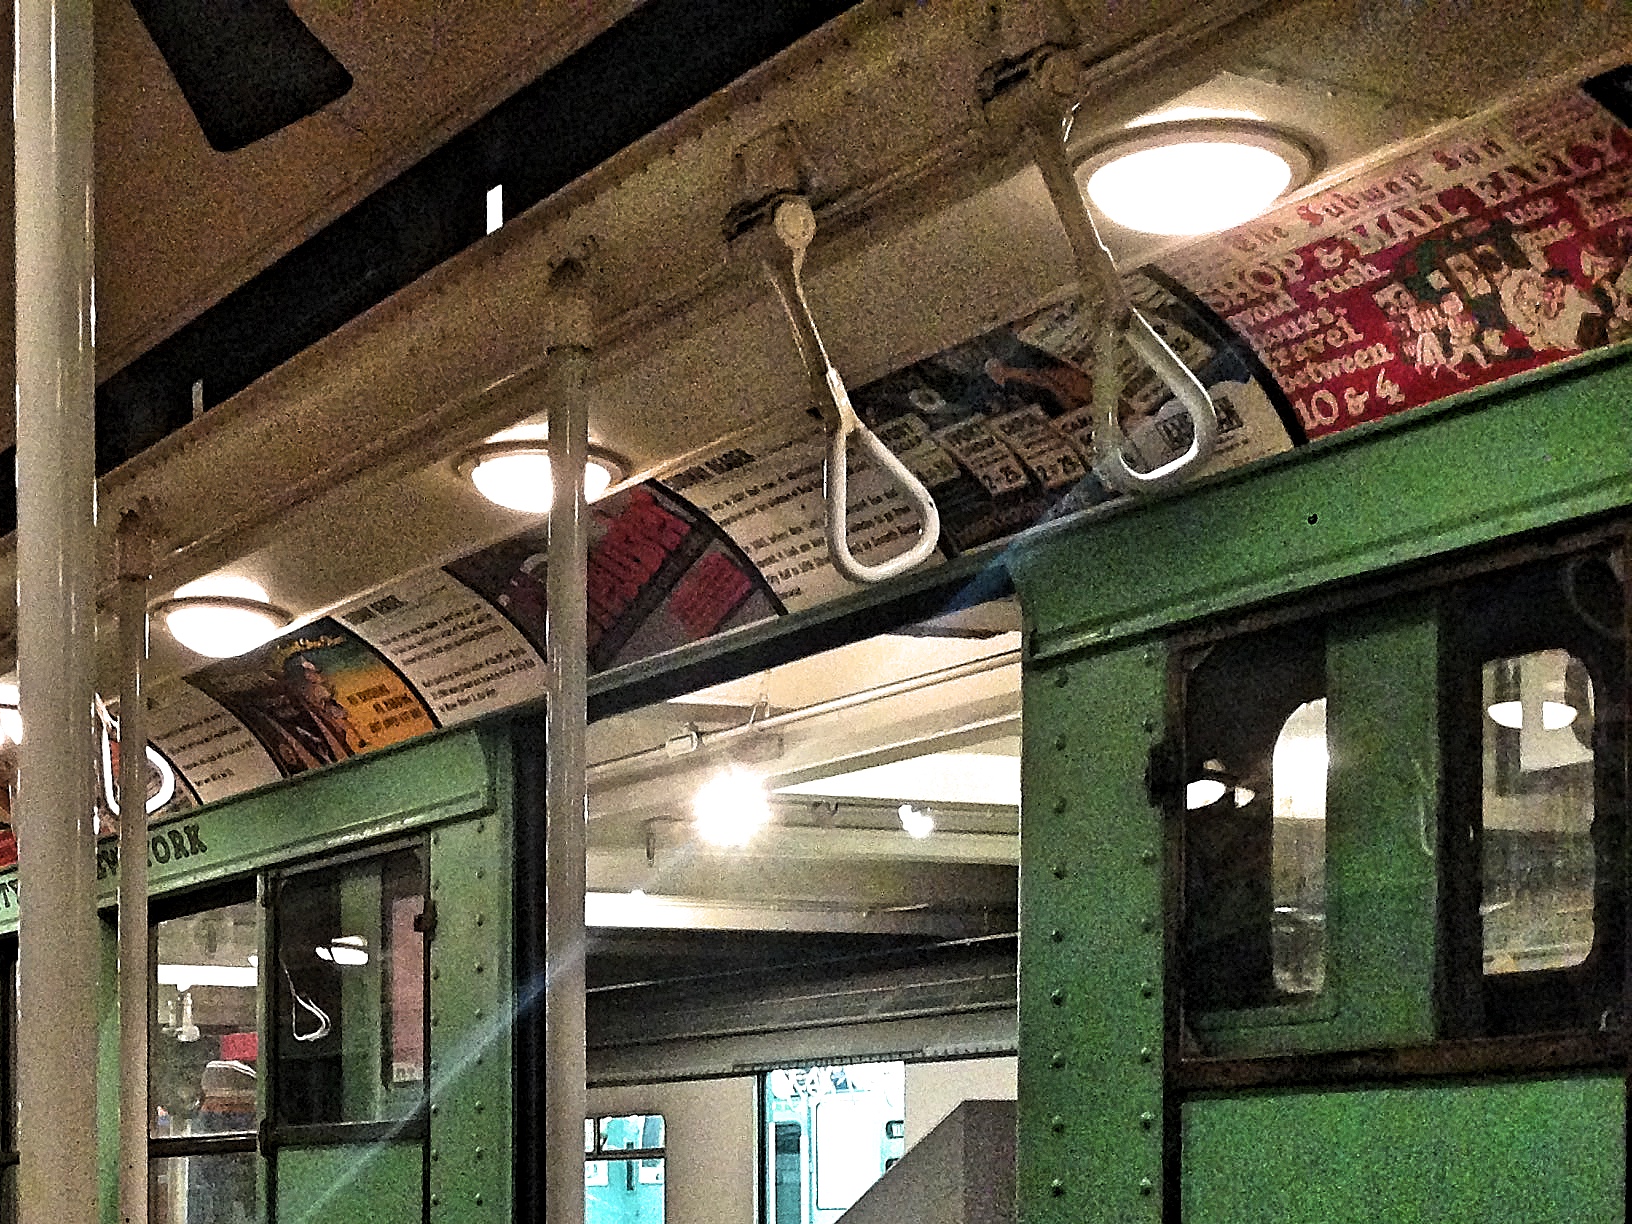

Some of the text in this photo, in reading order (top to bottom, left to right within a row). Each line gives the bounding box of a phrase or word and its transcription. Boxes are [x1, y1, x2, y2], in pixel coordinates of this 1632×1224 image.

[1297, 170, 1424, 228] Subway
[1432, 138, 1506, 173] Sun
[1206, 253, 1306, 312] SHOP
[1314, 246, 1343, 268] &
[1344, 190, 1471, 257] MAIL
[1462, 128, 1622, 209] EARLY
[1307, 258, 1390, 299] rush
[1274, 343, 1394, 393] between
[1295, 367, 1405, 431] 10 & 4
[148, 824, 207, 867] ORK
